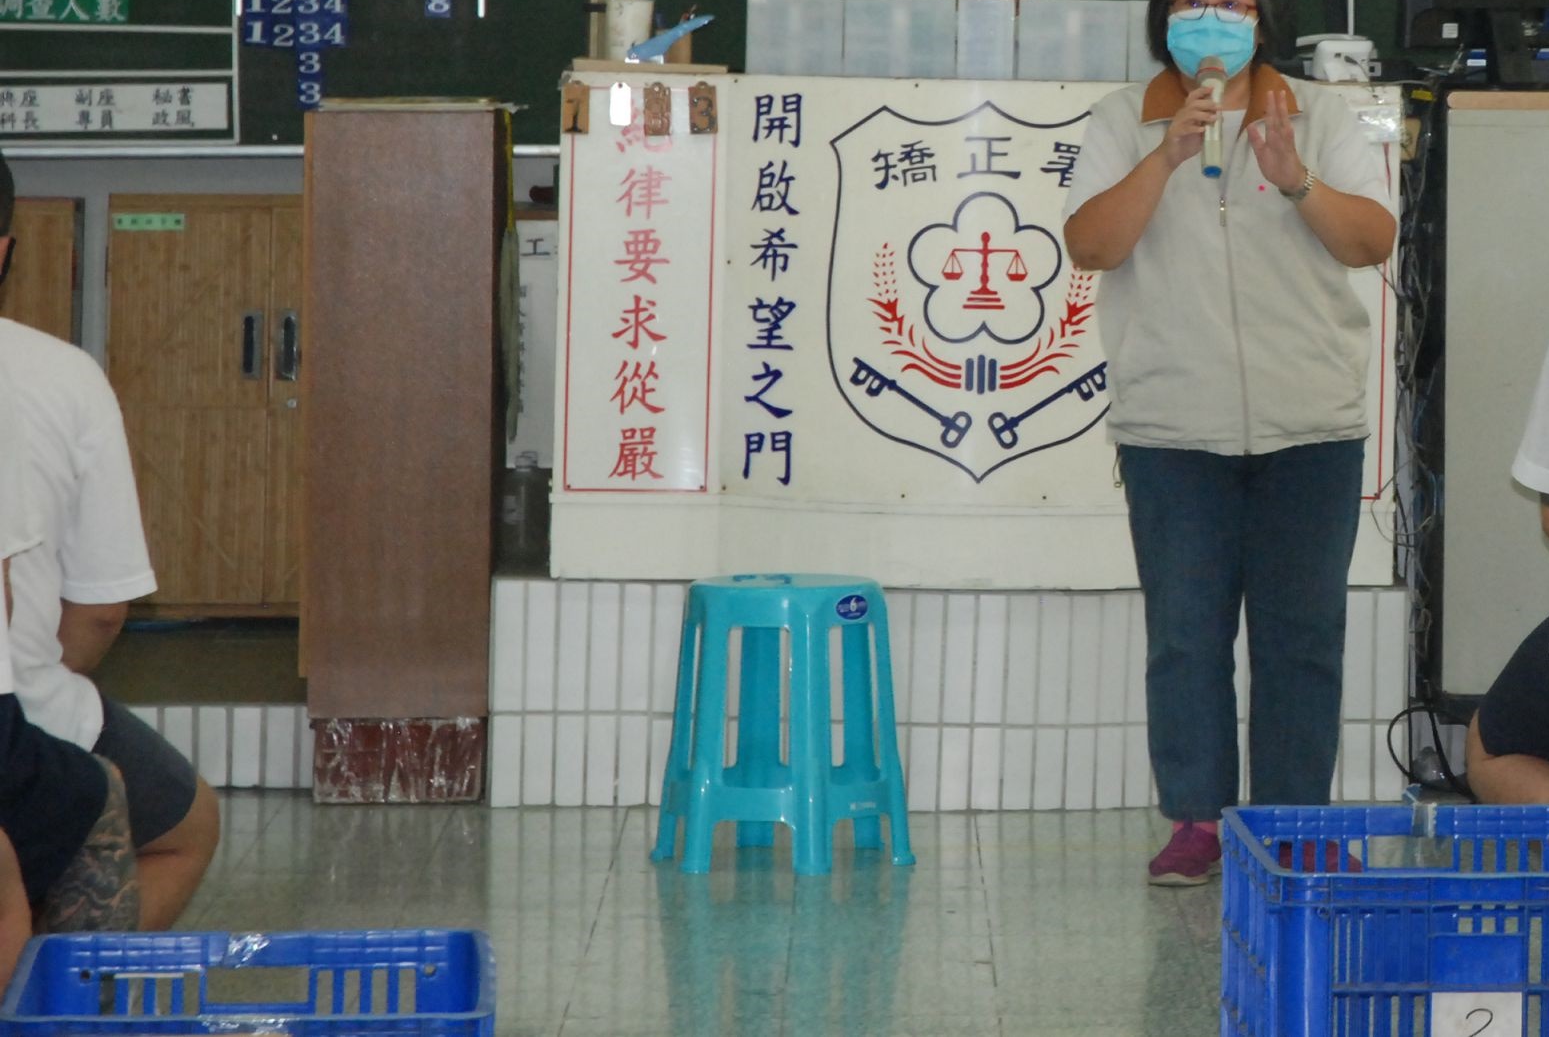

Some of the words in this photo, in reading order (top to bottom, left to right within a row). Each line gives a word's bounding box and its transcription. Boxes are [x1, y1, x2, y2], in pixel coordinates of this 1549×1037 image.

[871, 136, 1080, 190] 矯正署
[742, 93, 802, 486] 開啟希望之門
